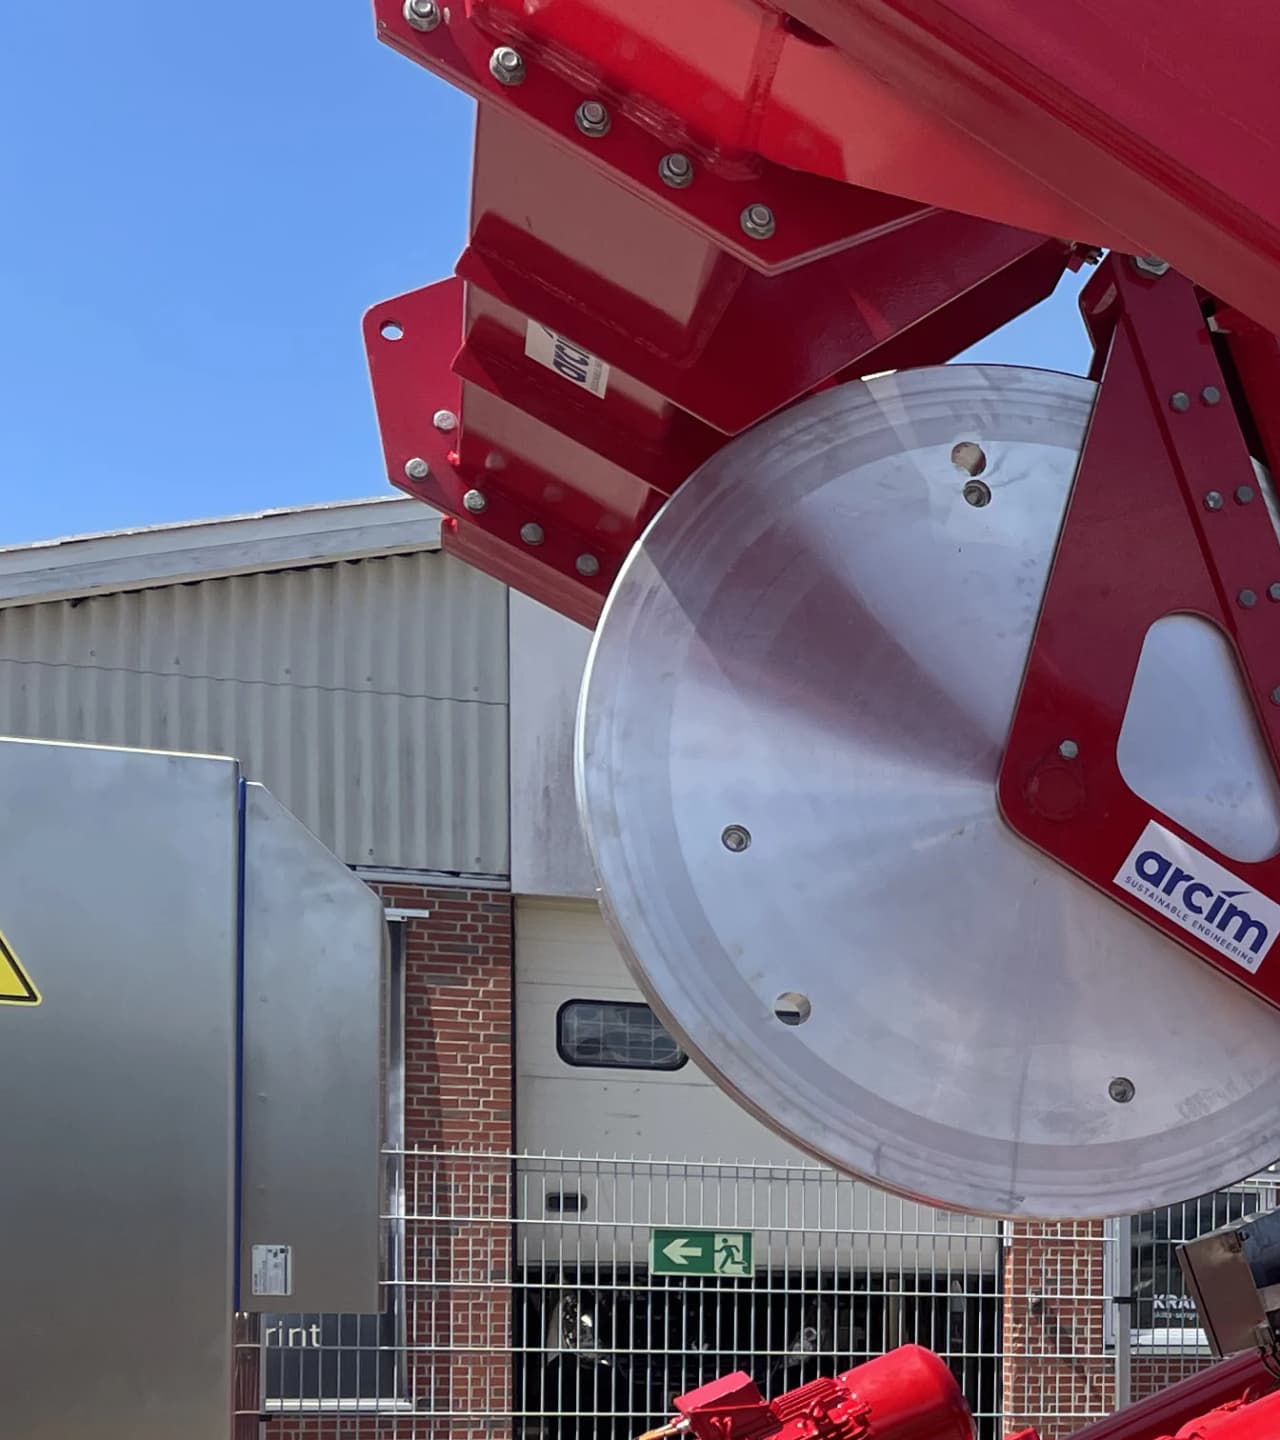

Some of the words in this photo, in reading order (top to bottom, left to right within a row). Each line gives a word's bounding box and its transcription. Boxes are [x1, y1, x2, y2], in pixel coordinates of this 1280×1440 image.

[1125, 875, 1189, 922] SUSTAINABLE
[1192, 919, 1255, 964] ENGINEERING
[1153, 1294, 1196, 1309] KRA
